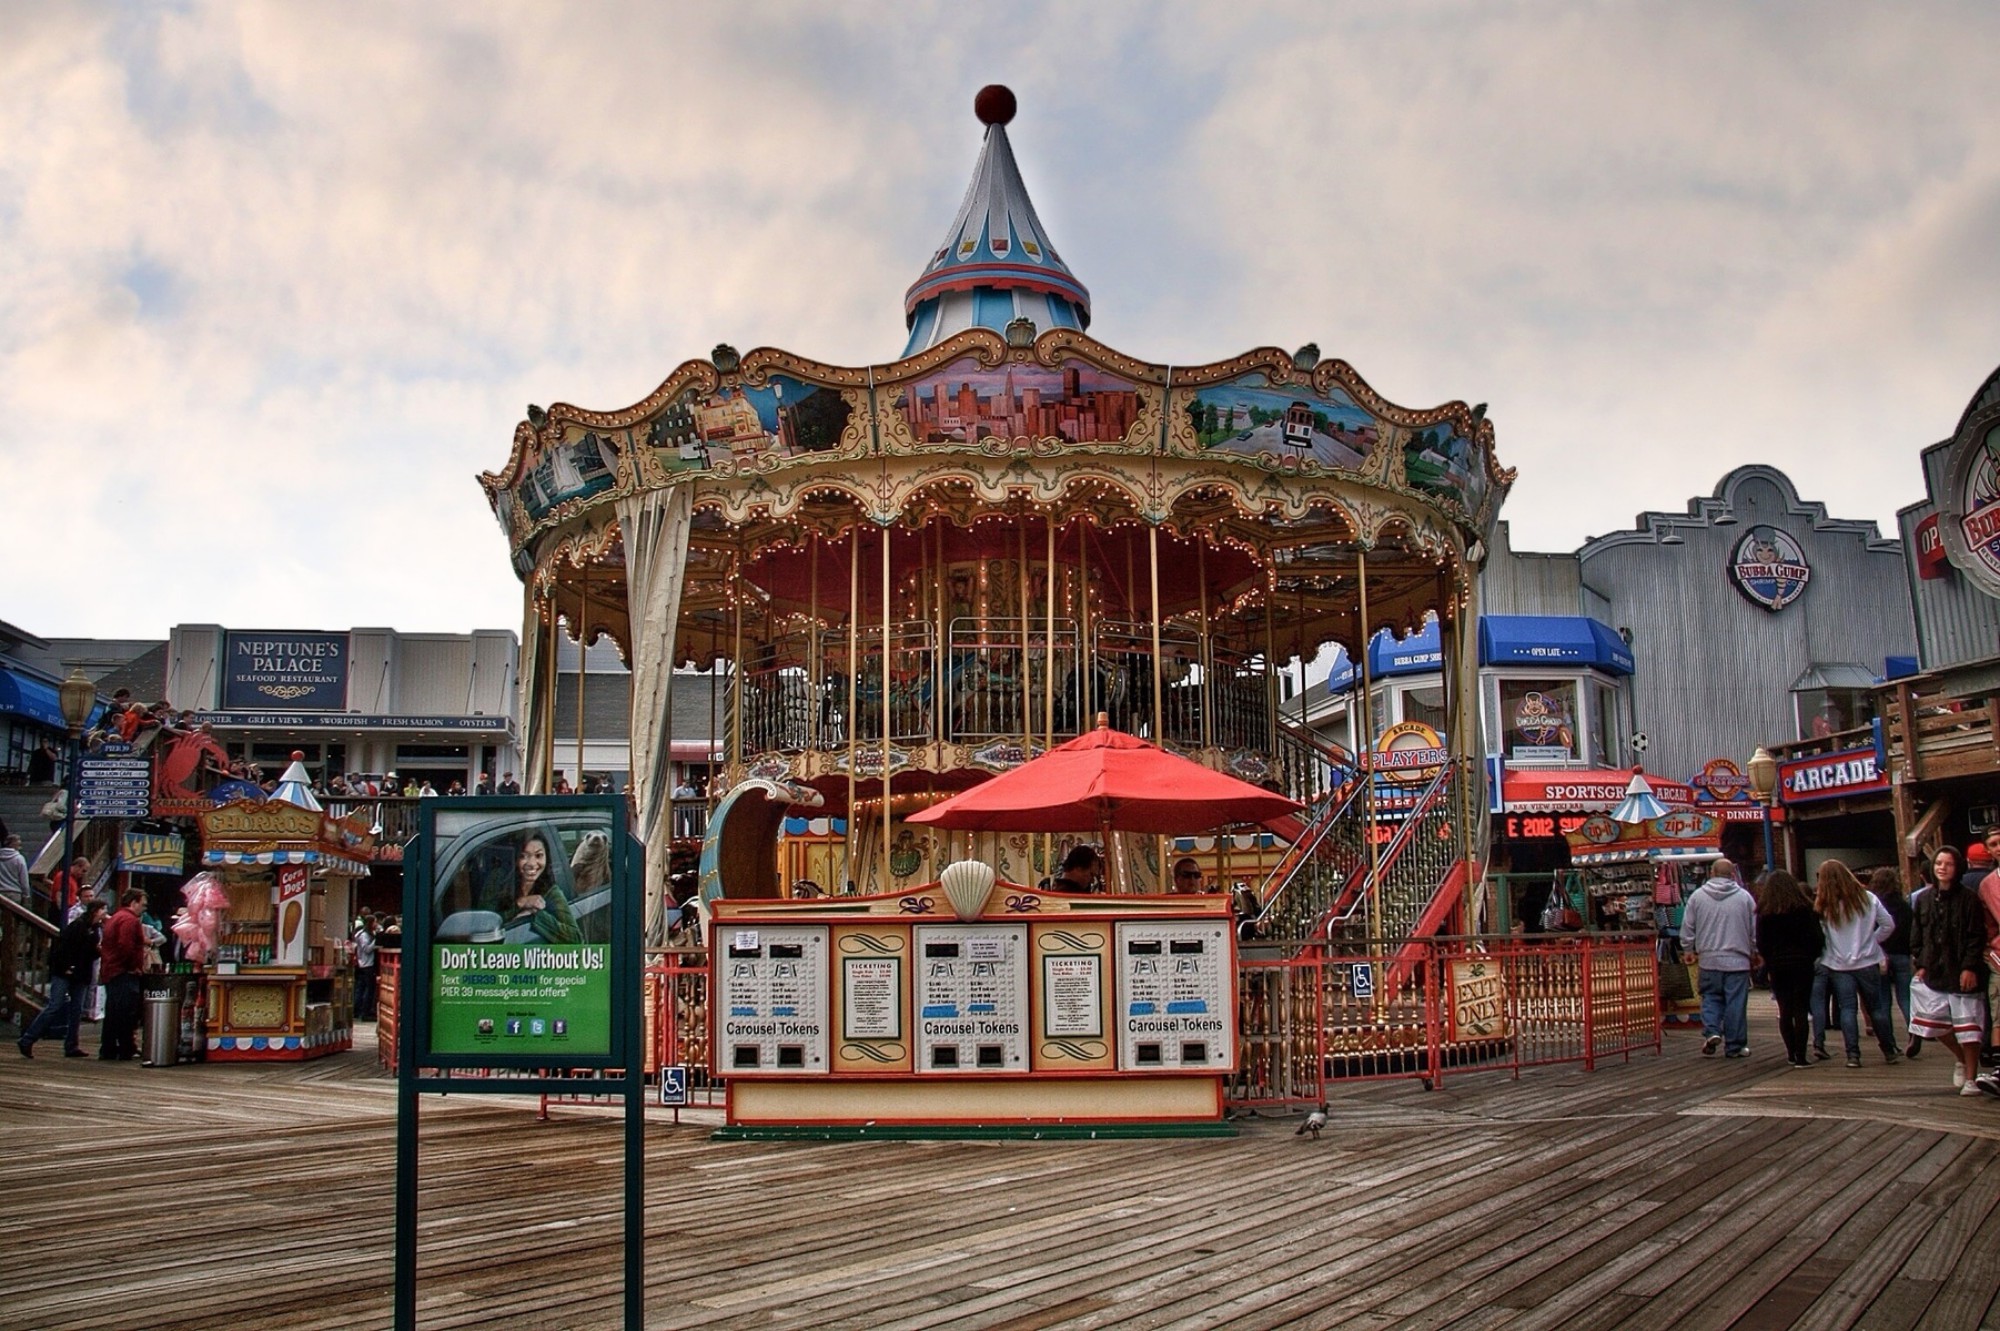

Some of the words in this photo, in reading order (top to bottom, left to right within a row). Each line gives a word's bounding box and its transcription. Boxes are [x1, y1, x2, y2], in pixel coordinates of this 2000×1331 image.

[1738, 565, 1773, 577] BUBBA
[1776, 565, 1806, 579] GUMP
[238, 642, 339, 657] NEPTUNE'S
[1531, 648, 1546, 656] OPEN
[1547, 648, 1561, 656] LATE
[253, 658, 322, 672] PALACE
[1394, 656, 1413, 666] BUBBA
[1413, 654, 1429, 664] GUMP
[236, 674, 276, 682] SEAFOOD
[280, 675, 338, 683] RESTAURANT
[247, 716, 276, 724] GREAT
[279, 716, 304, 724] VIEWS
[320, 717, 368, 725] SWORDFISH
[459, 719, 497, 727] OYSTERS
[1393, 725, 1426, 736] ARCADE
[1372, 749, 1449, 768] PLAYERS
[1793, 757, 1879, 793] ARCADE
[1656, 787, 1688, 802] ARCADE
[1523, 817, 1555, 837] 2012
[282, 869, 304, 885] Corn
[284, 879, 306, 897] Dogs
[441, 948, 477, 970] Don't
[480, 948, 521, 969] Leave
[524, 948, 580, 970] Without
[582, 947, 604, 970] Us!
[441, 975, 460, 985] Text
[462, 974, 497, 985] PIER39
[498, 975, 510, 985] TO
[511, 974, 538, 985] 41411
[539, 975, 554, 985] for
[554, 975, 587, 988] special
[151, 988, 171, 998] real
[441, 986, 460, 997] PIER
[461, 986, 474, 997] 39
[474, 987, 519, 1000] messages
[520, 986, 537, 997] and
[1457, 977, 1498, 1003] EXIT
[1456, 997, 1500, 1026] ONLY
[726, 1022, 777, 1035] Carousel
[780, 1022, 820, 1035] Tokens
[924, 1021, 975, 1035] Carousel
[978, 1021, 1020, 1034] Tokens
[1128, 1018, 1179, 1033] Carousel
[1182, 1017, 1223, 1031] Tokens
